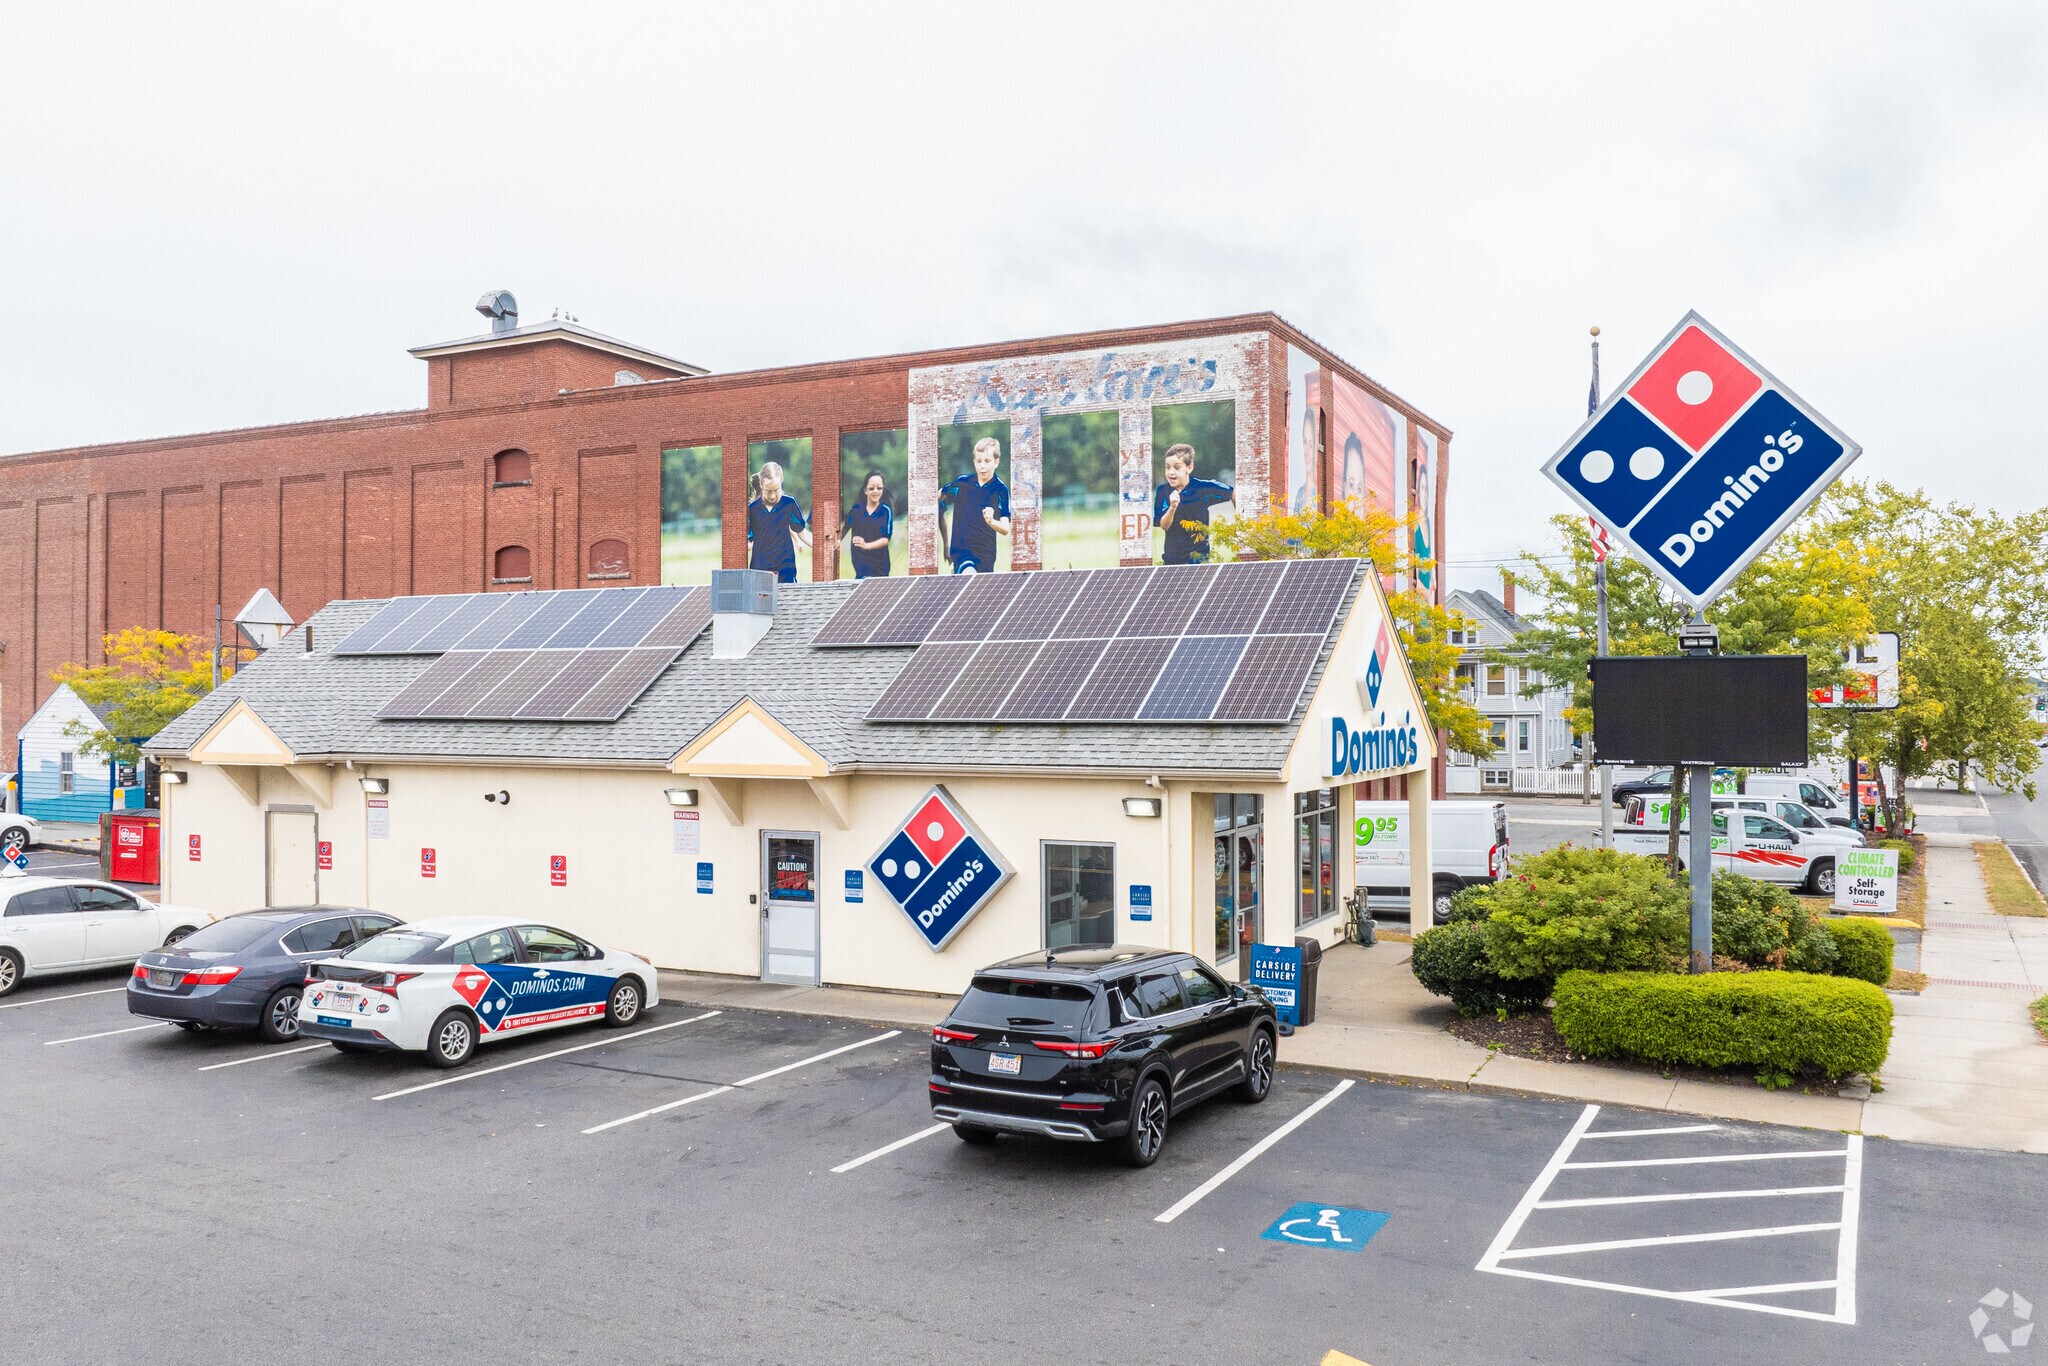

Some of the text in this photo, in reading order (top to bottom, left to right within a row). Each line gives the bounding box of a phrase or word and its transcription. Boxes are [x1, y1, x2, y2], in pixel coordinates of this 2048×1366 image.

[1659, 429, 1804, 568] Domino's
[1332, 710, 1418, 777] Domino's
[1848, 852, 1885, 865] CLIMATE
[777, 861, 807, 871] CAUTION!
[1838, 864, 1894, 878] CONTROLLED
[1857, 879, 1877, 888] Self-
[917, 859, 984, 929] Domino's
[1848, 886, 1885, 899] Storage
[1255, 960, 1296, 971] CARSIDE
[1255, 970, 1296, 980] DELIVERY
[511, 976, 586, 996] DOMINOS.COM
